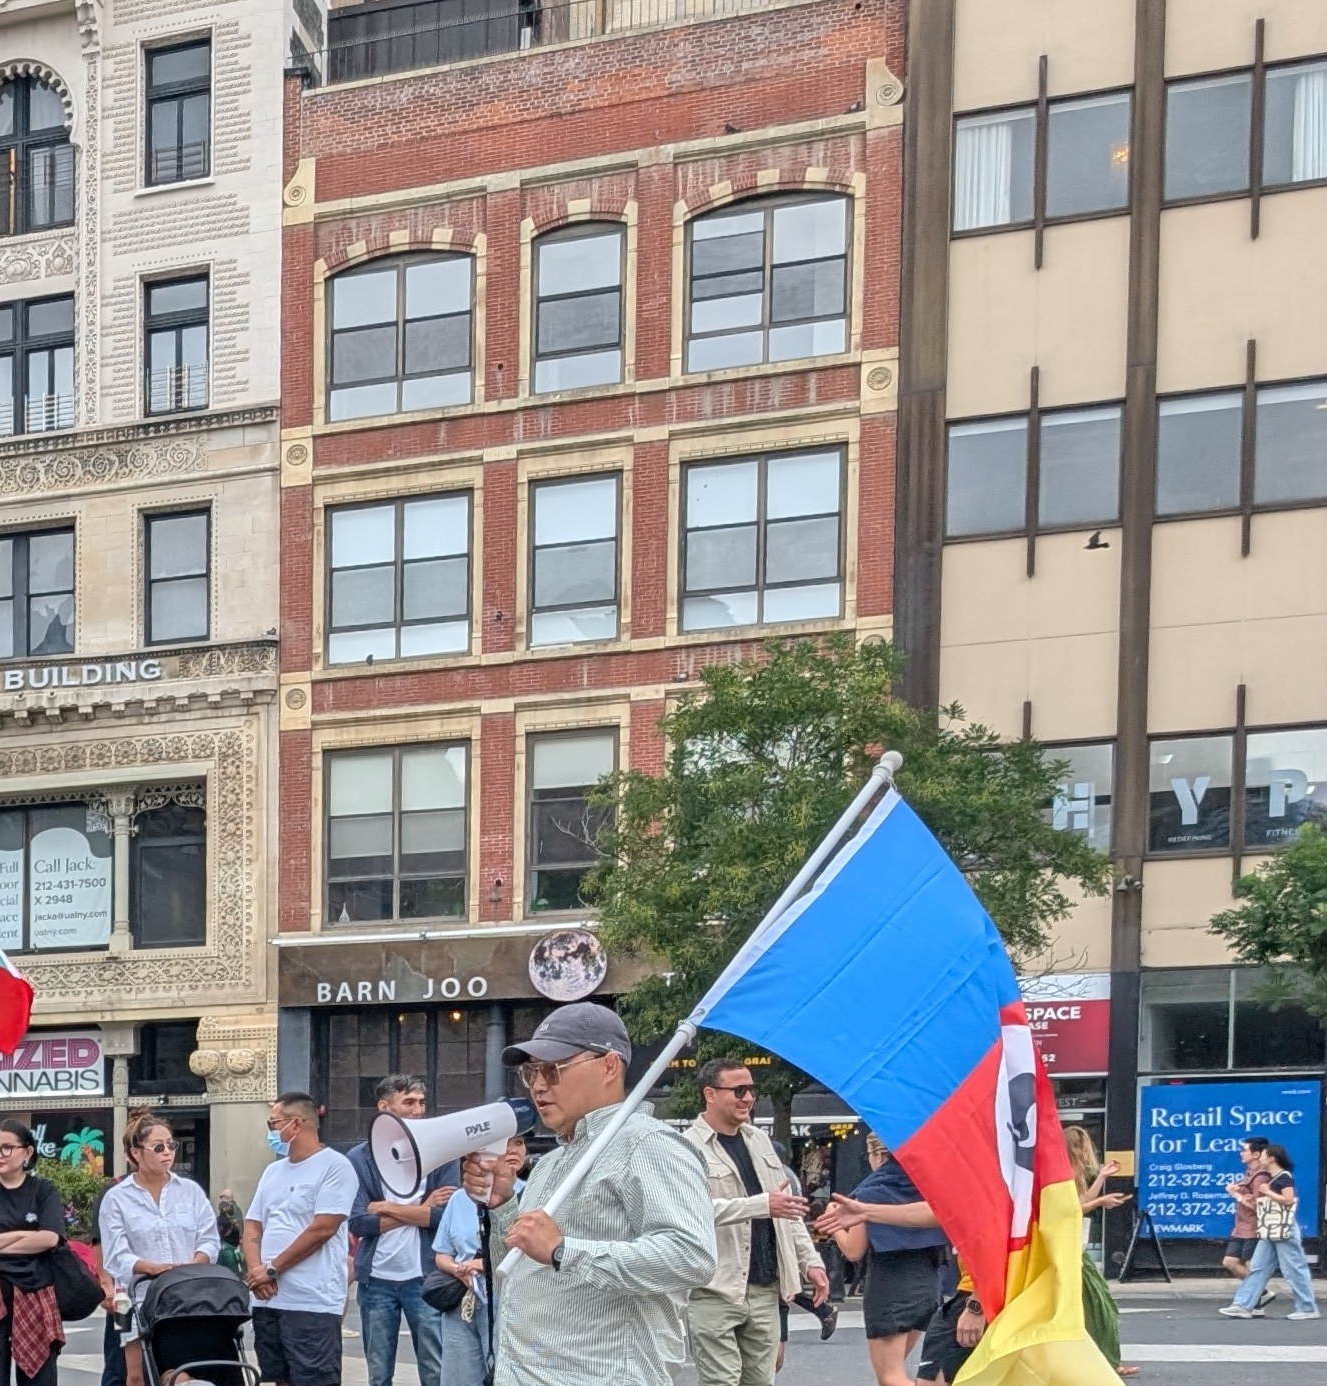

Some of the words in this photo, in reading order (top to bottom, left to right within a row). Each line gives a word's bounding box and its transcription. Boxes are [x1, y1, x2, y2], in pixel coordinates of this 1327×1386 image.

[4, 658, 162, 692] BUILDING
[0, 861, 19, 874] Full
[34, 859, 61, 874] Call
[65, 857, 96, 874] Jack:
[34, 877, 107, 891] 212-431-7500
[45, 894, 73, 905] 2948
[317, 980, 396, 1003] BARN
[422, 975, 489, 999] JOO
[1150, 1105, 1223, 1128] Retail
[1230, 1105, 1303, 1132] Space
[465, 1121, 491, 1136] PYLE
[1150, 1133, 1187, 1154] for
[1195, 1132, 1245, 1153] Leas
[1149, 1163, 1172, 1172] Craig
